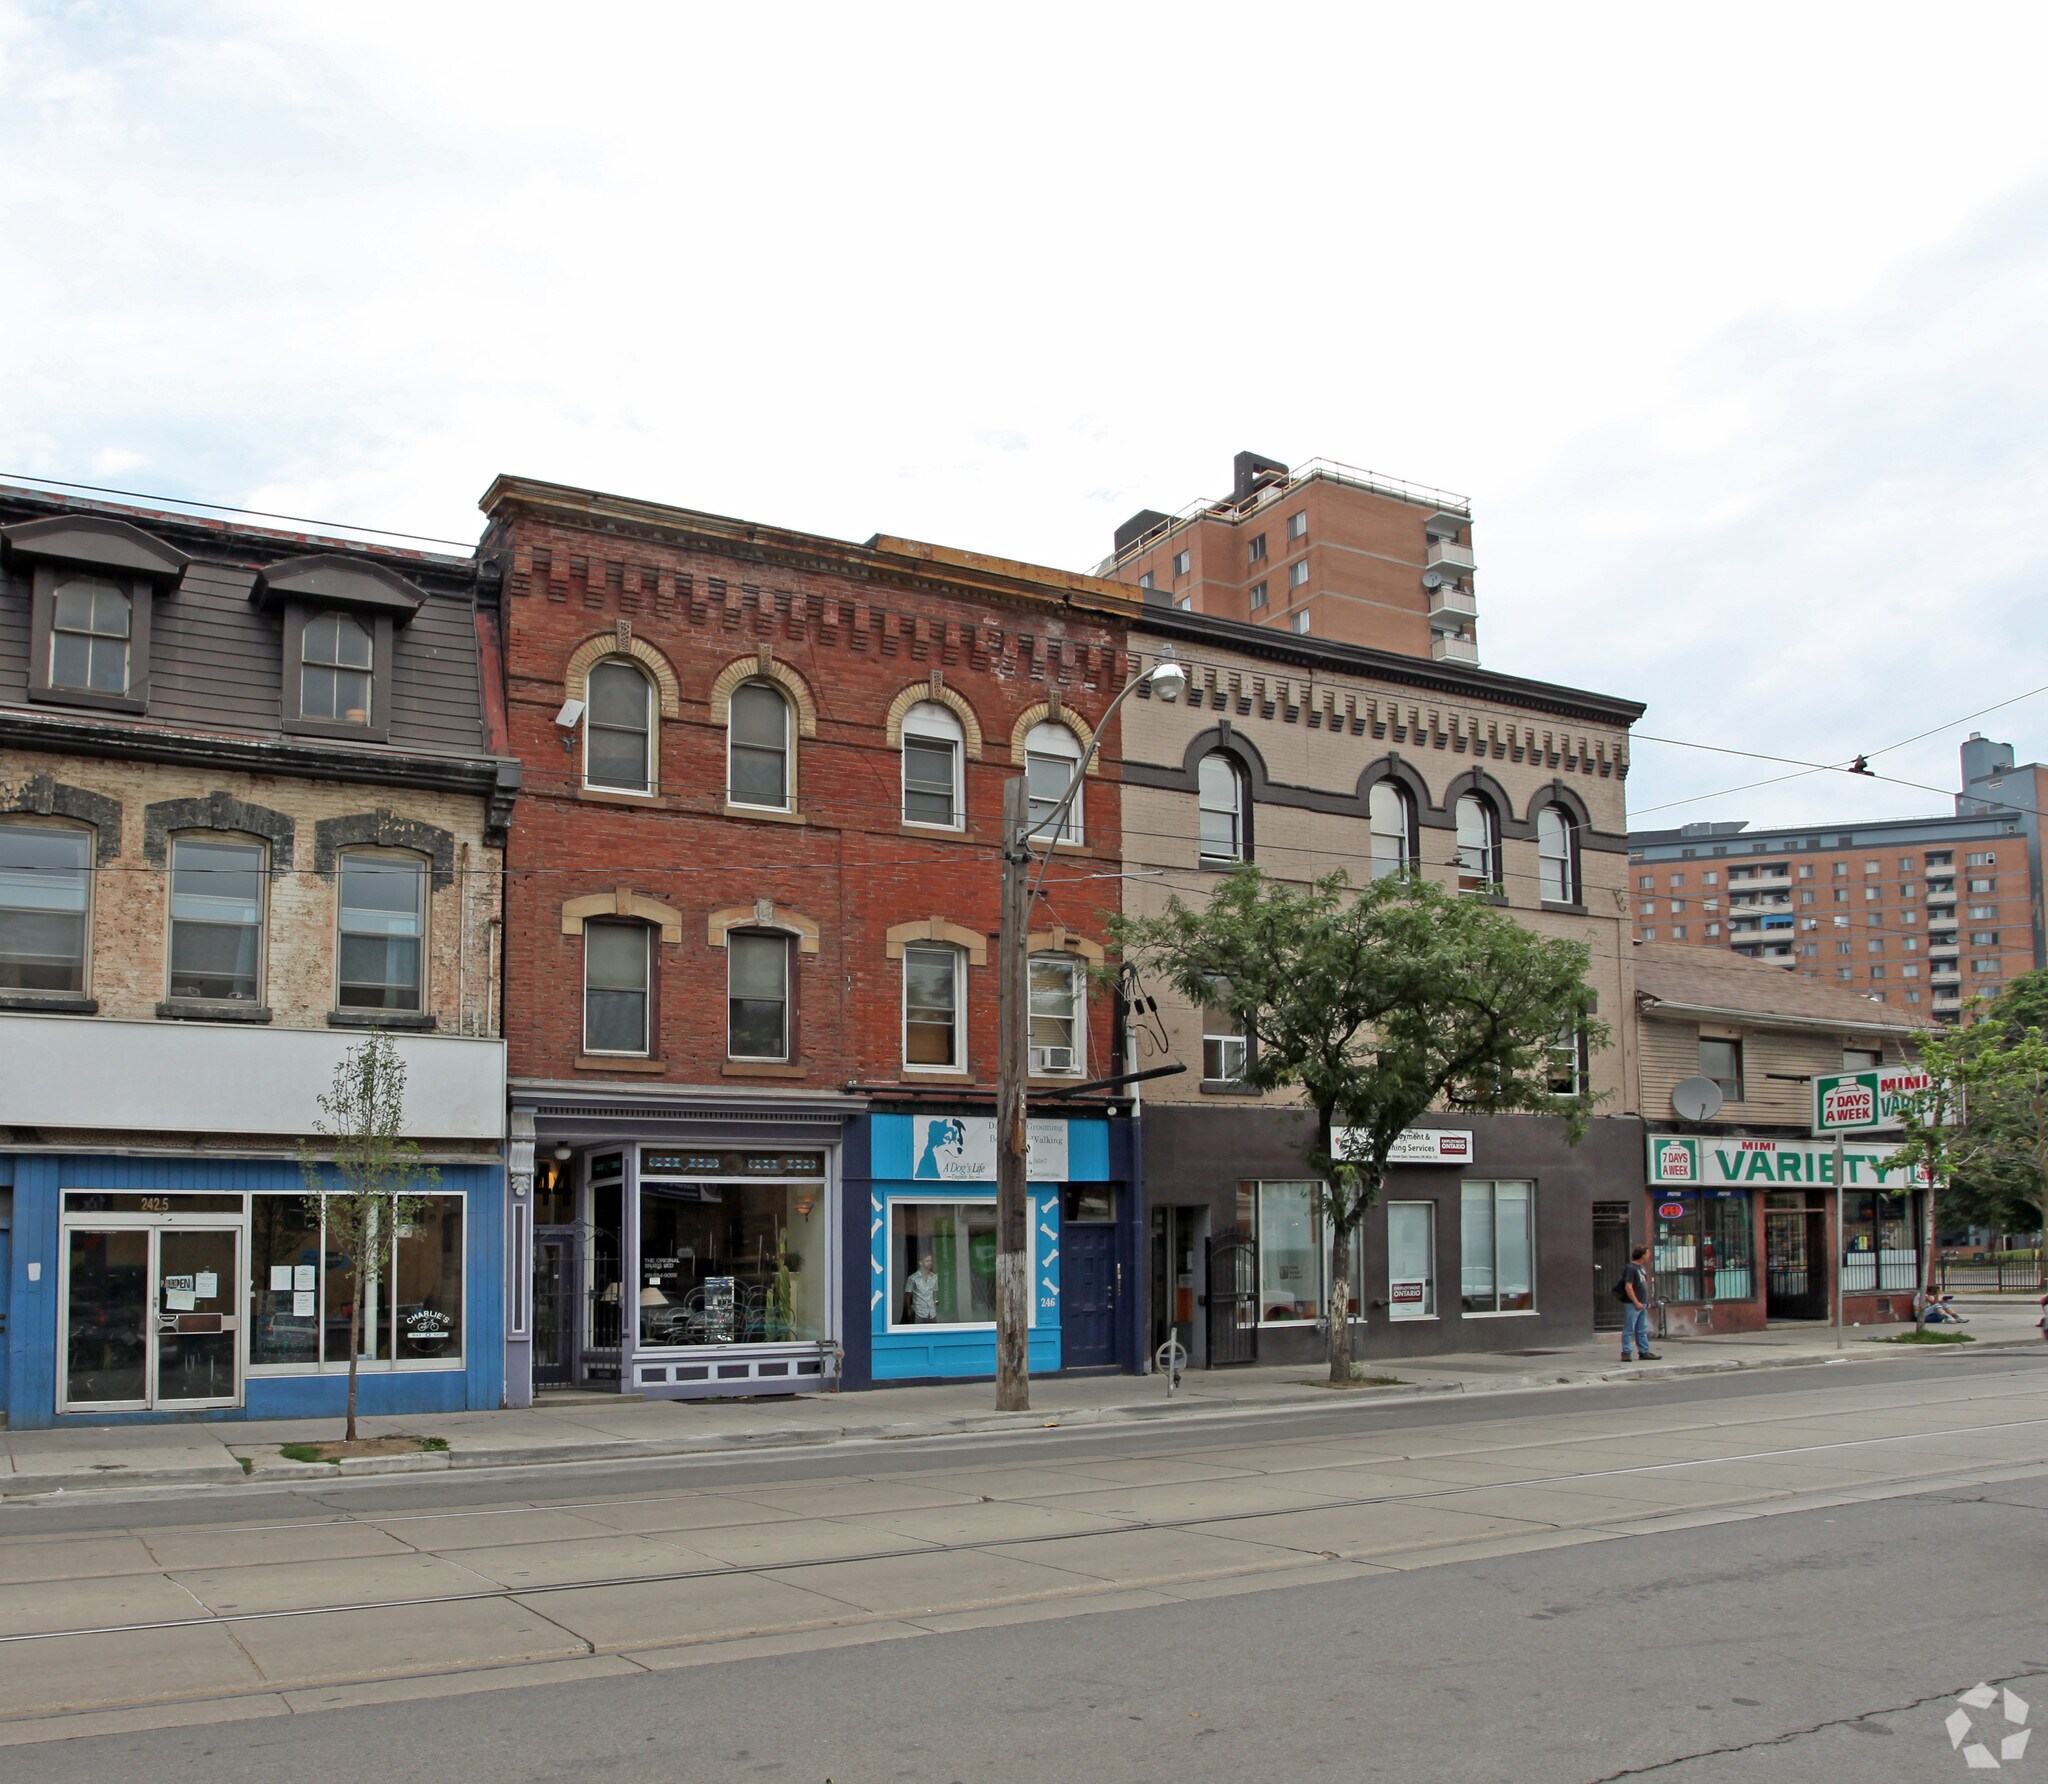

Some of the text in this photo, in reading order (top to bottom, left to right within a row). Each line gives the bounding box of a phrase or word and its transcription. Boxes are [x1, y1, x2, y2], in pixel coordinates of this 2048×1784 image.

[1880, 1075, 1928, 1092] MIMI
[1825, 1094, 1870, 1108] 7 DAYS
[1825, 1107, 1870, 1122] A WEEK
[1026, 1121, 1063, 1132] Grooming
[1408, 1144, 1435, 1152] Services
[1741, 1141, 1776, 1151] MIMI
[1662, 1153, 1688, 1163] 7 DAYS
[943, 1162, 986, 1175] A Dog's Life
[1663, 1165, 1689, 1176] A WEEK
[1715, 1149, 1893, 1184] VARIETY
[141, 1197, 169, 1211] 242.5
[1041, 1298, 1056, 1307] 246
[406, 1310, 450, 1324] CHARLIE'S
